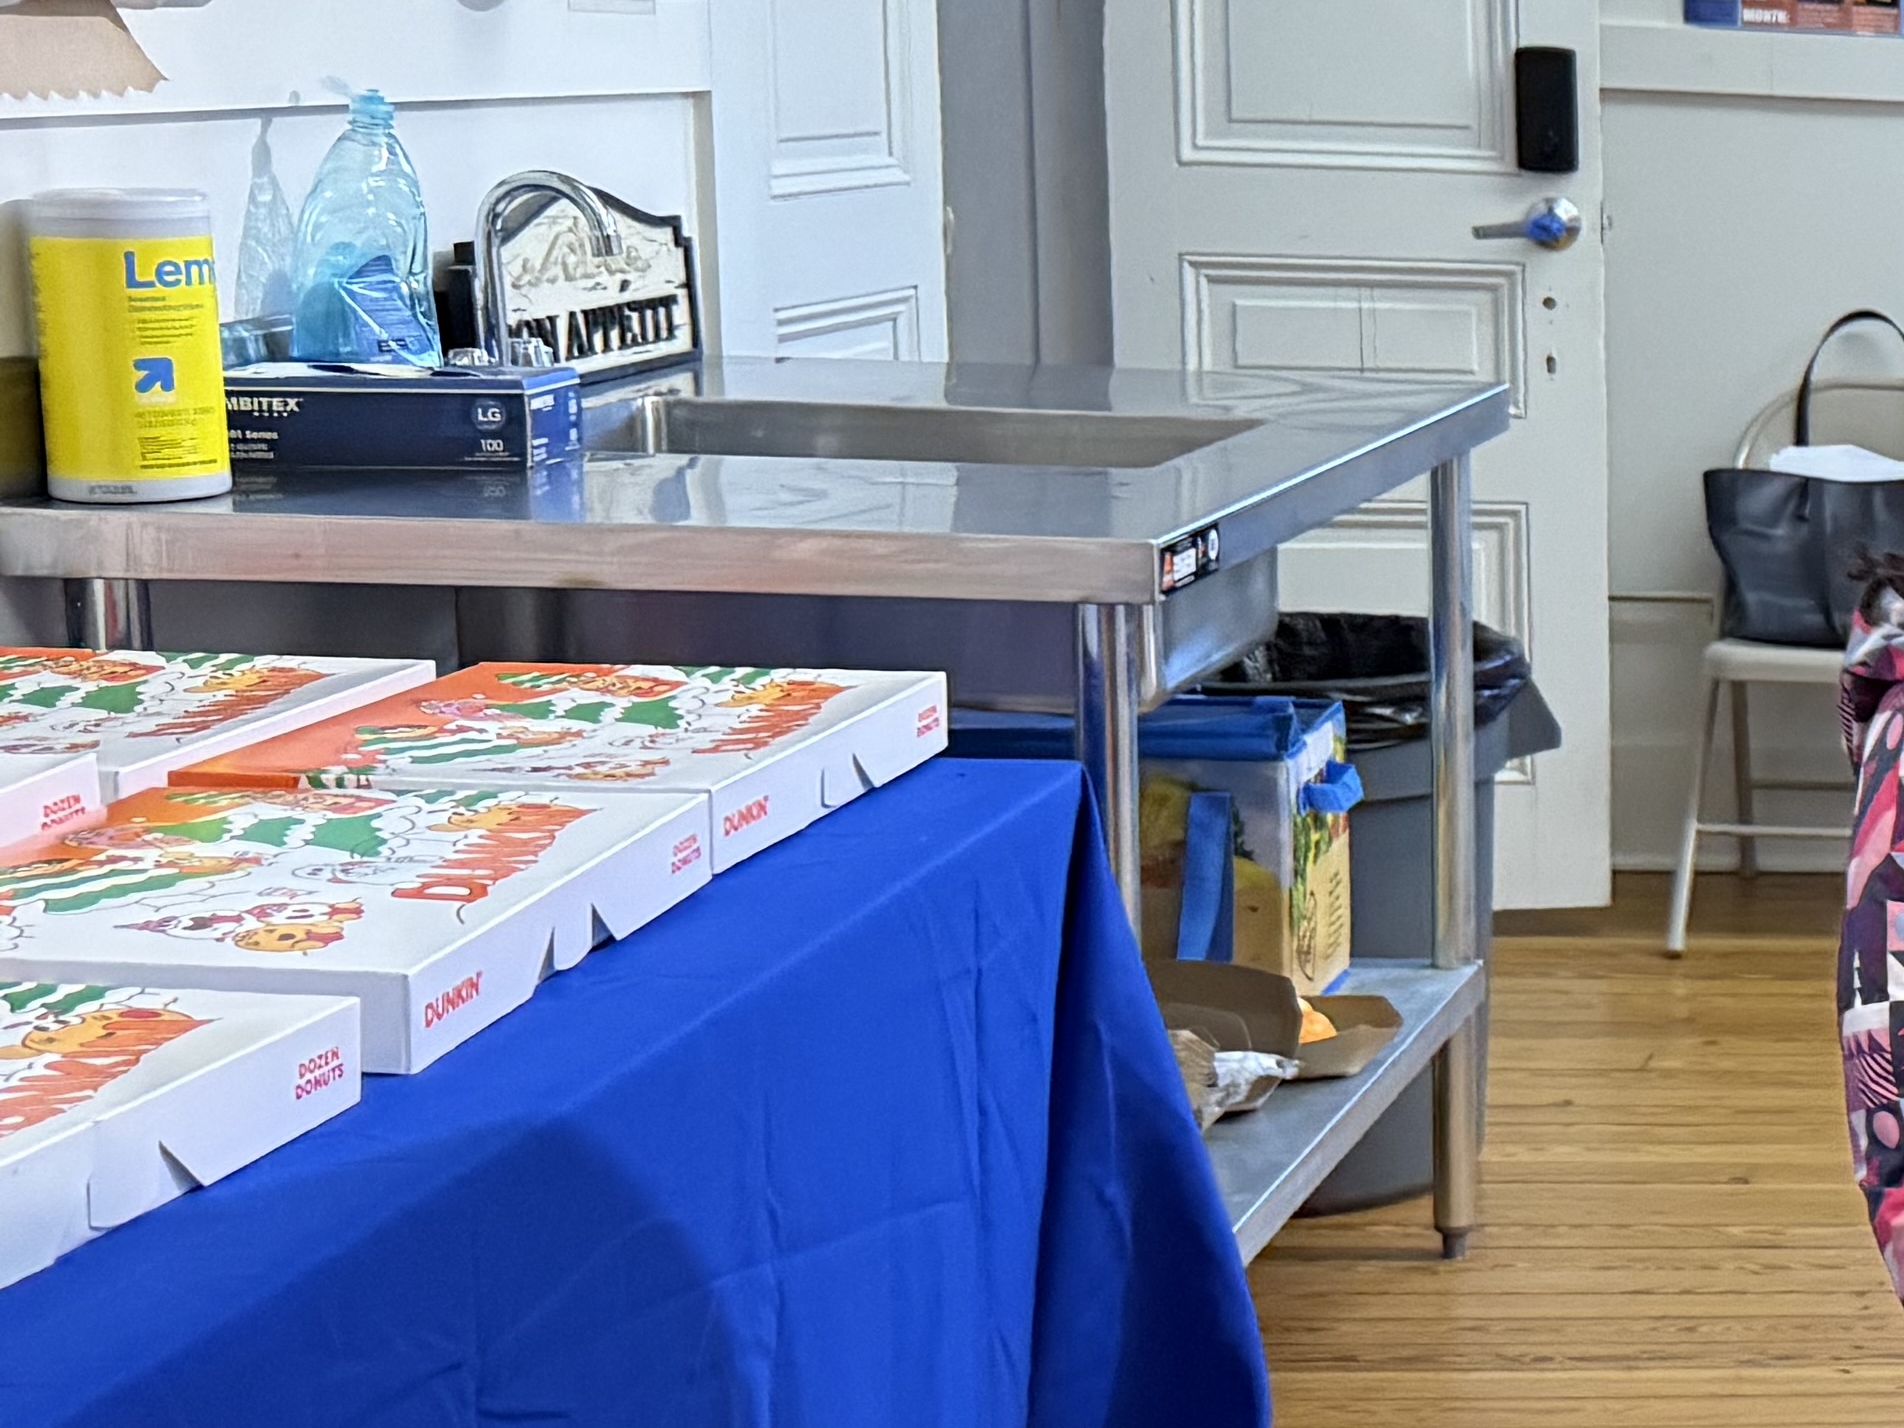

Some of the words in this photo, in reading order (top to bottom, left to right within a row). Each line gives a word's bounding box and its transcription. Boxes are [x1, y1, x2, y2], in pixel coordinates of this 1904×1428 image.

[124, 251, 216, 290] Lem
[477, 408, 502, 422] LG
[480, 439, 504, 452] 100
[43, 793, 82, 819] DOZEN
[298, 1046, 341, 1079] DOZEN
[295, 1063, 345, 1100] DONUTS
